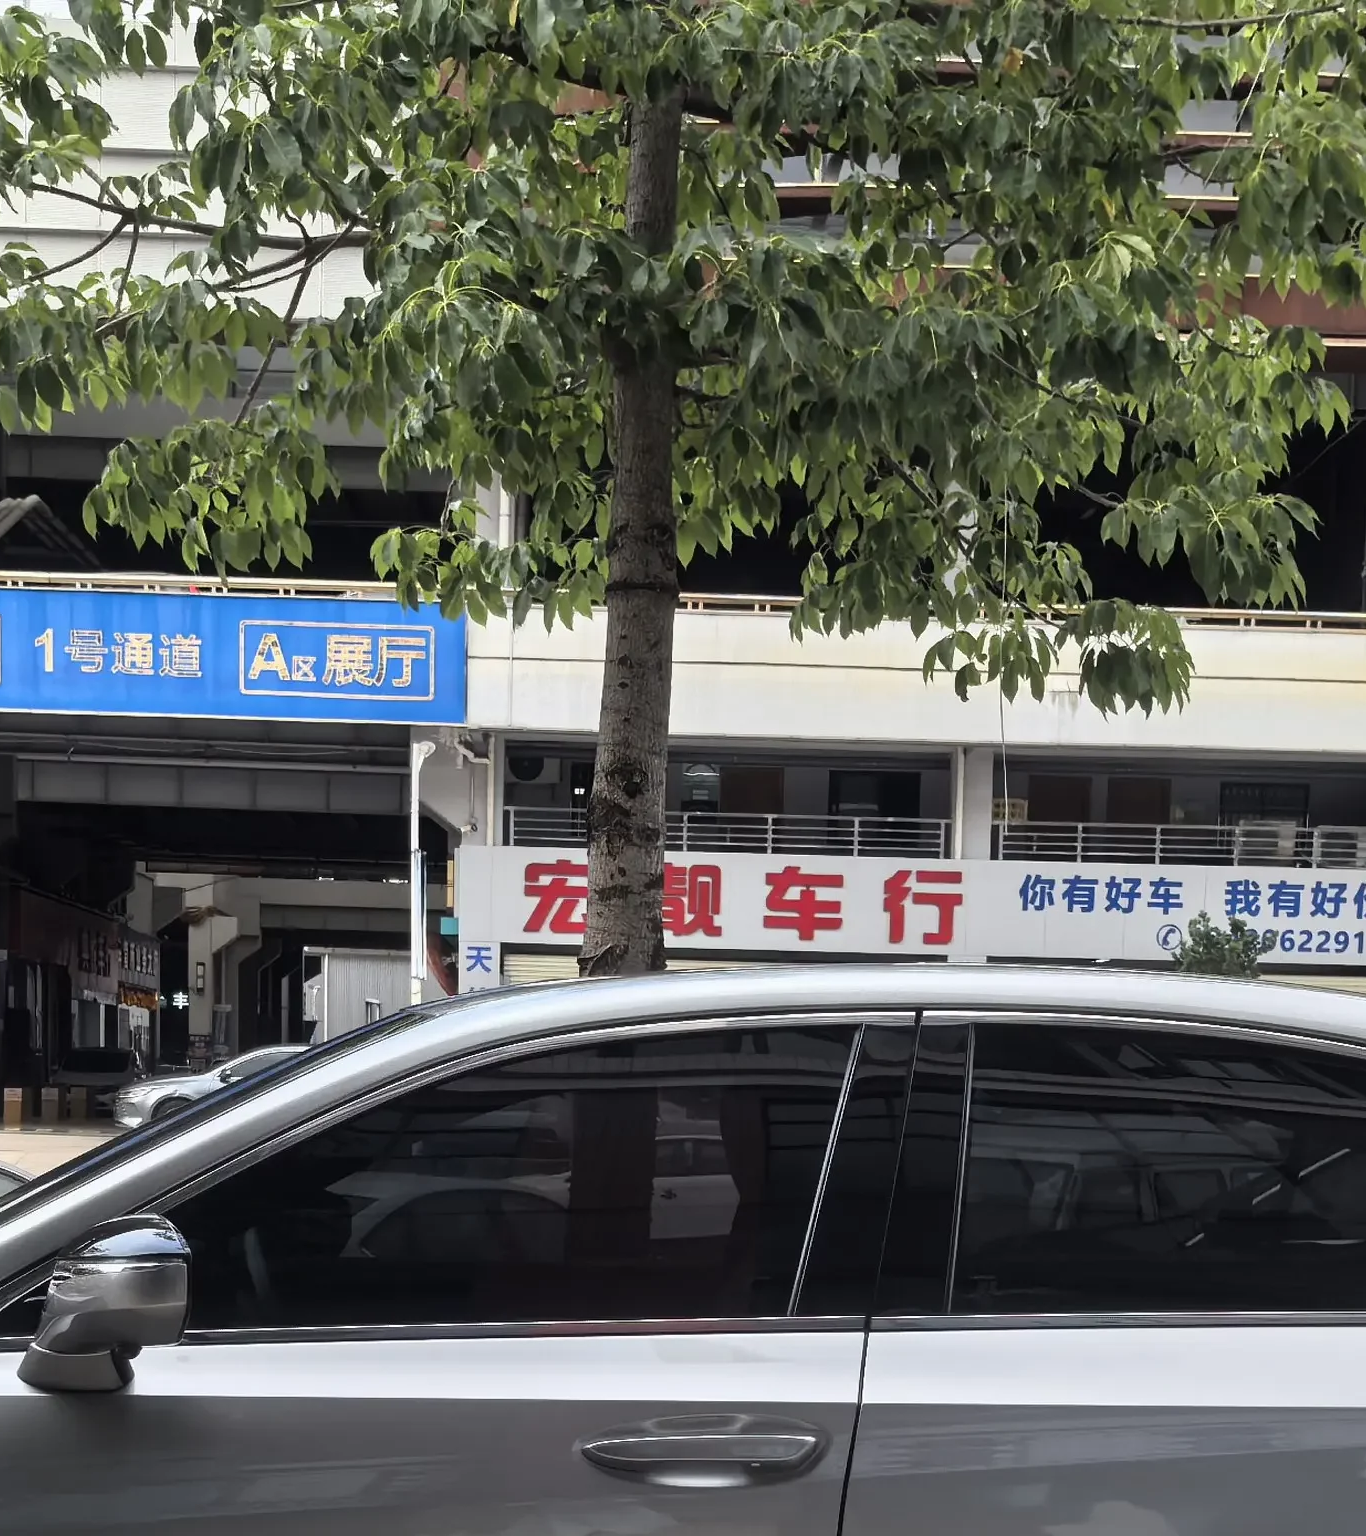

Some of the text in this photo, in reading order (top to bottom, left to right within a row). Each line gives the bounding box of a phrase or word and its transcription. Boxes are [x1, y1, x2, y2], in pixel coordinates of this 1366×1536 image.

[34, 628, 202, 678] 1号通道
[248, 633, 426, 688] A区展厅
[1019, 874, 1183, 915] 你有好车
[466, 946, 492, 973] 天
